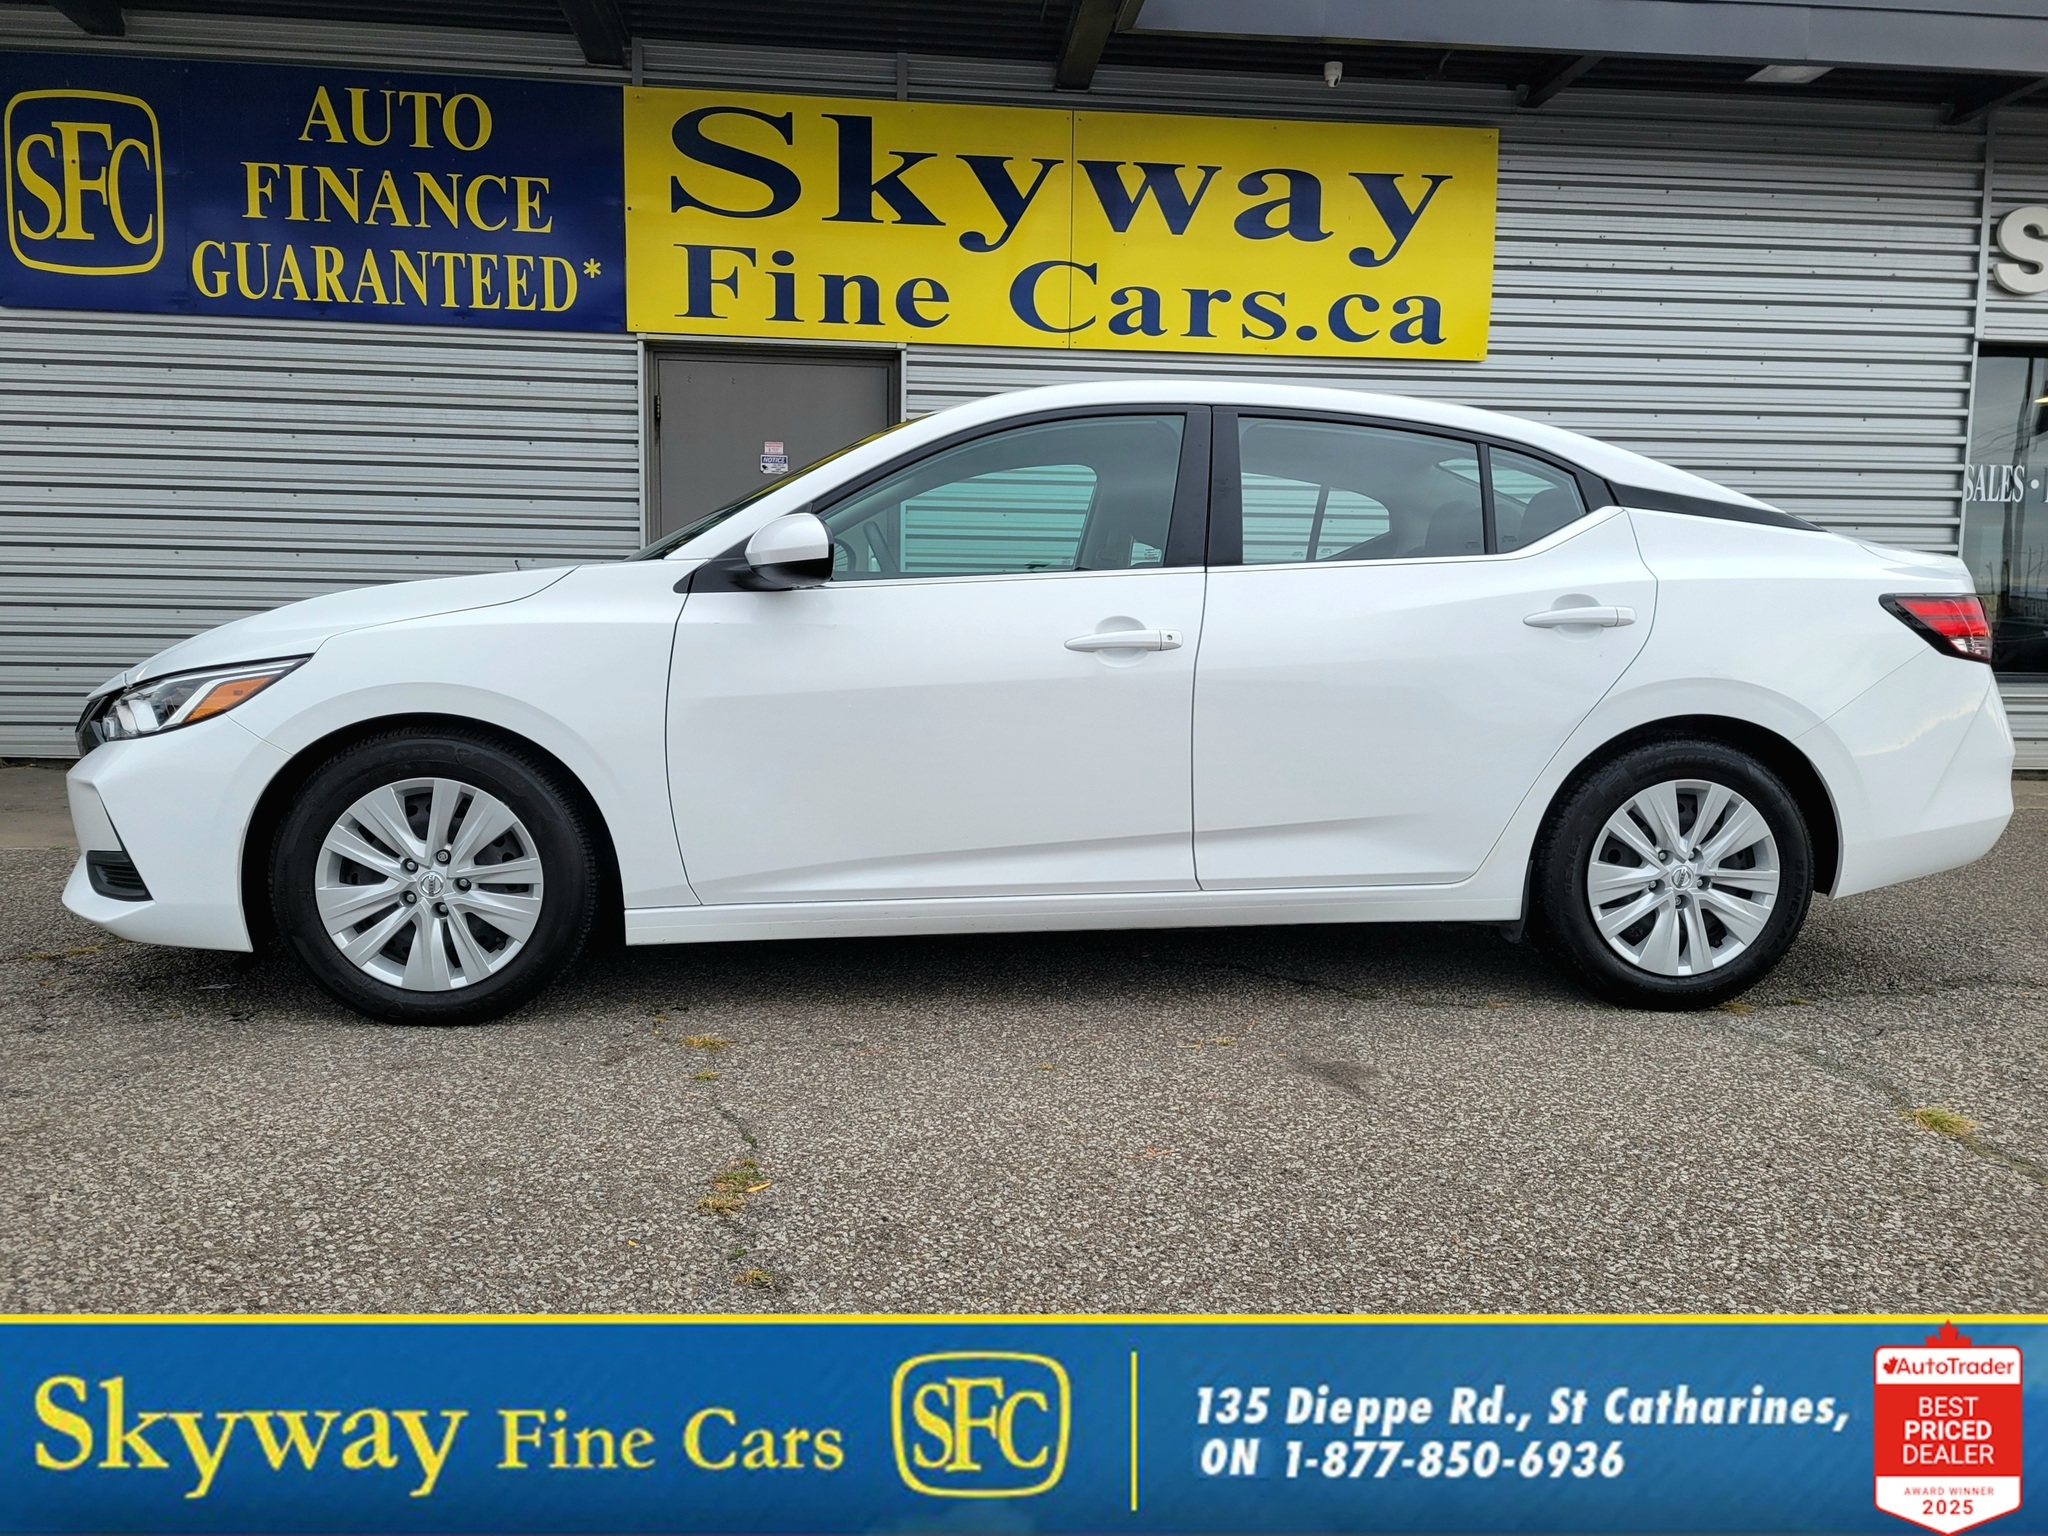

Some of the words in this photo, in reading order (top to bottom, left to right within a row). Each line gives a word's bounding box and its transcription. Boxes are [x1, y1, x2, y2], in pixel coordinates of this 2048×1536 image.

[298, 86, 493, 152] AUTO
[17, 121, 153, 245] SFC
[241, 161, 553, 233] FINANCE
[670, 105, 1453, 268] Skyway
[673, 243, 950, 328] Fine
[1009, 260, 1447, 346] Cars.ca
